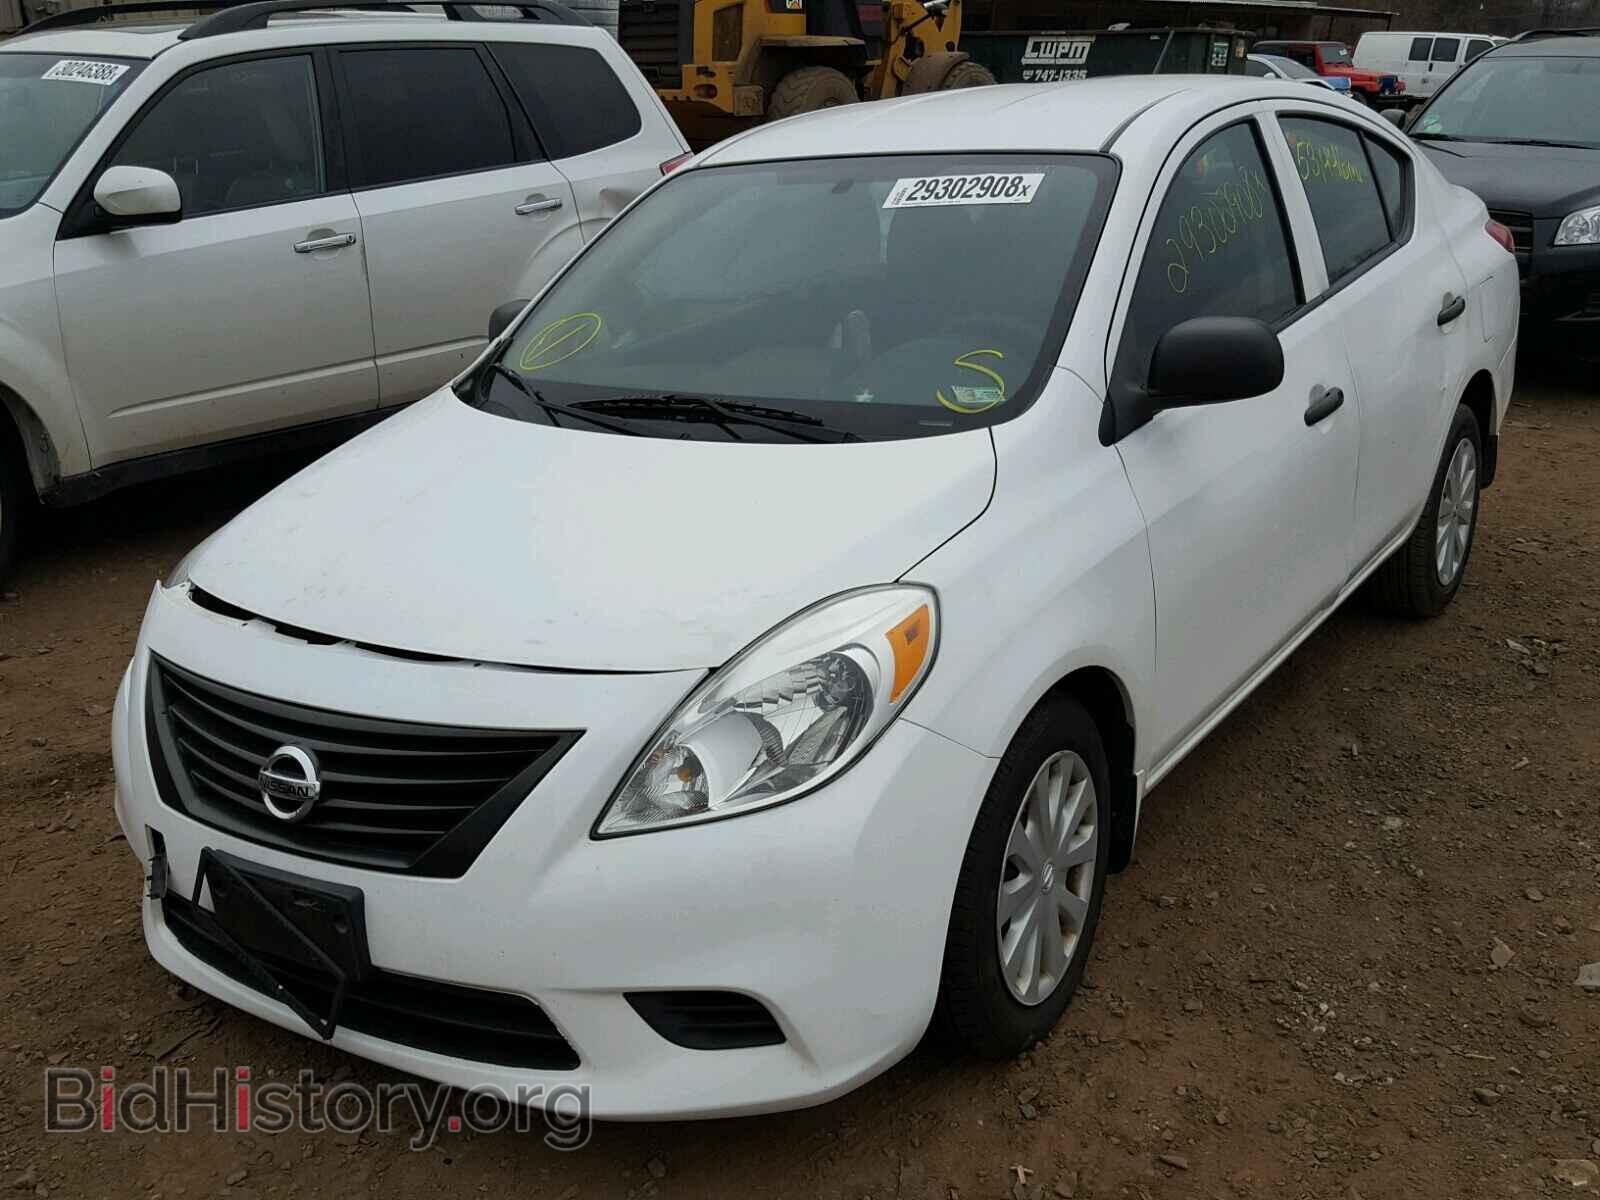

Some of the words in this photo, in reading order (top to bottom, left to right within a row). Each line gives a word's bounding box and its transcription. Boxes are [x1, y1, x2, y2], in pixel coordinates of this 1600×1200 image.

[1034, 69, 1088, 82] 747-1335
[905, 175, 1031, 201] 29302908x
[261, 773, 311, 798] NISSAN
